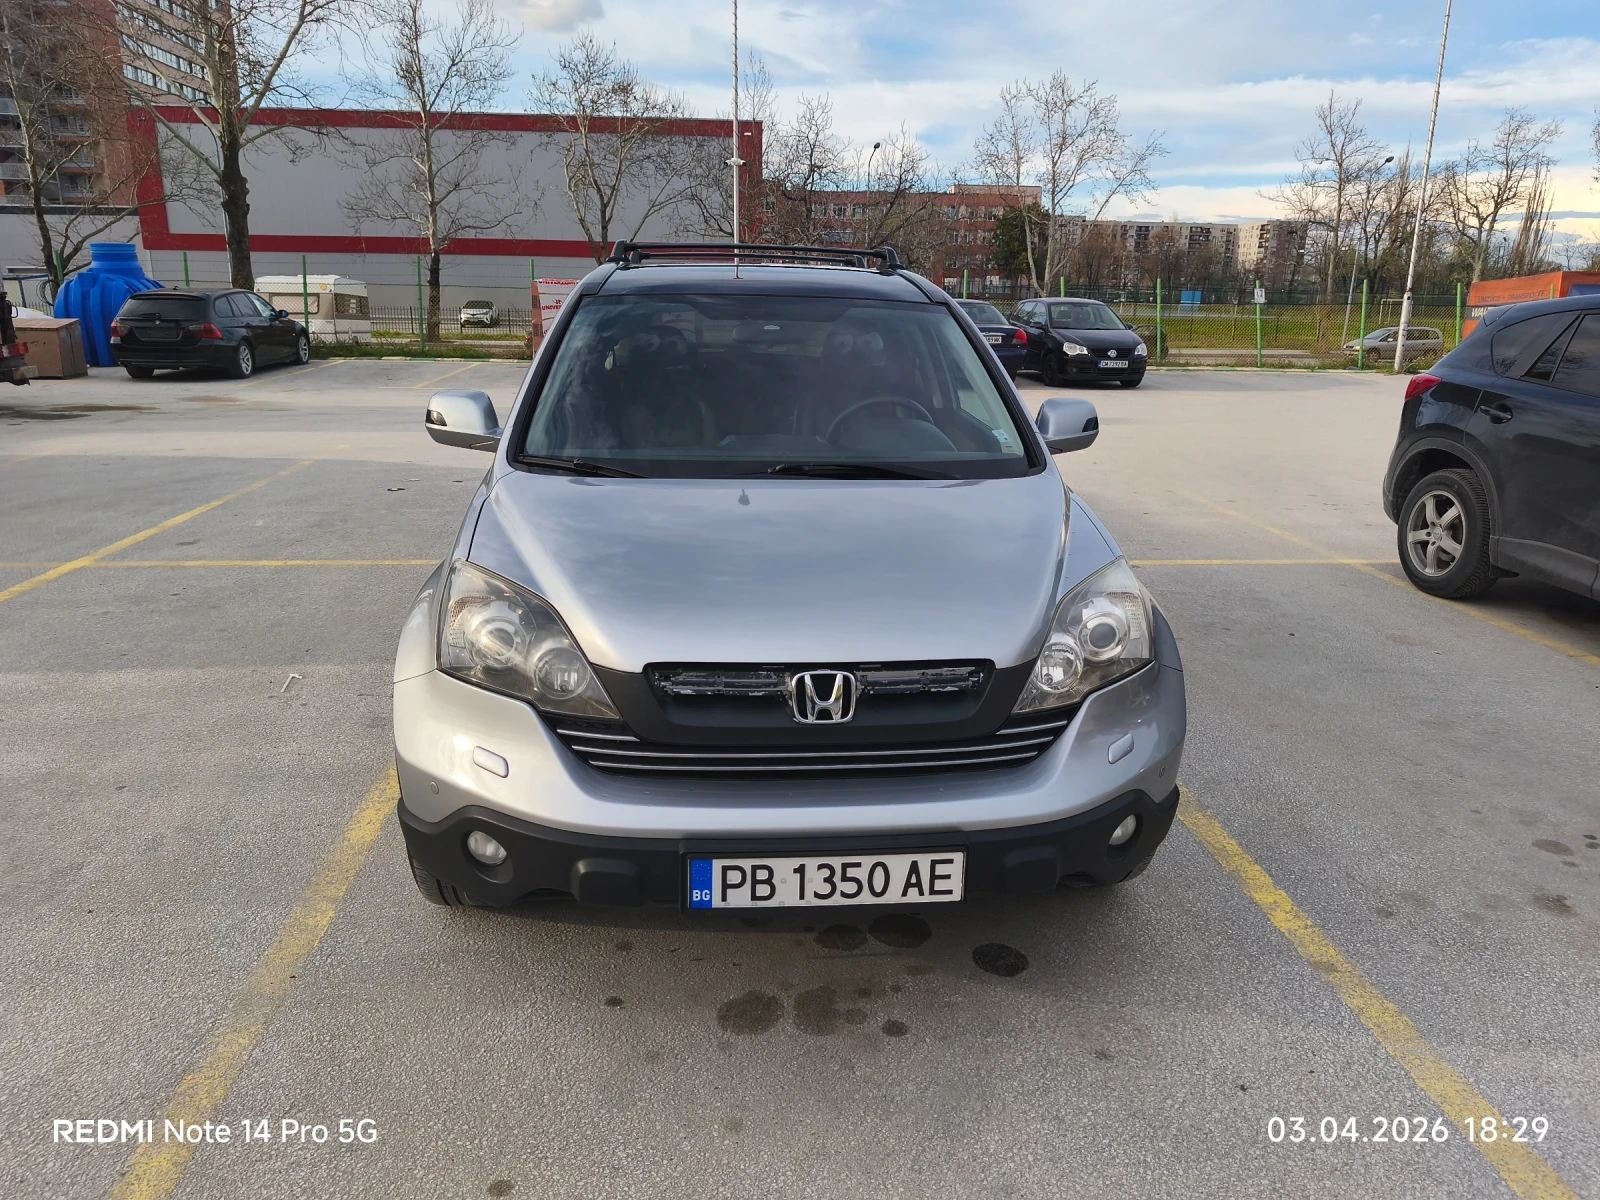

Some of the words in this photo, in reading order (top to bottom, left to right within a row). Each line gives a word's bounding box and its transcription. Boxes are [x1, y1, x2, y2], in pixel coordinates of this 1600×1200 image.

[721, 864, 776, 902] PB
[792, 860, 890, 901] 1350
[901, 859, 954, 897] AE
[692, 889, 711, 901] BG
